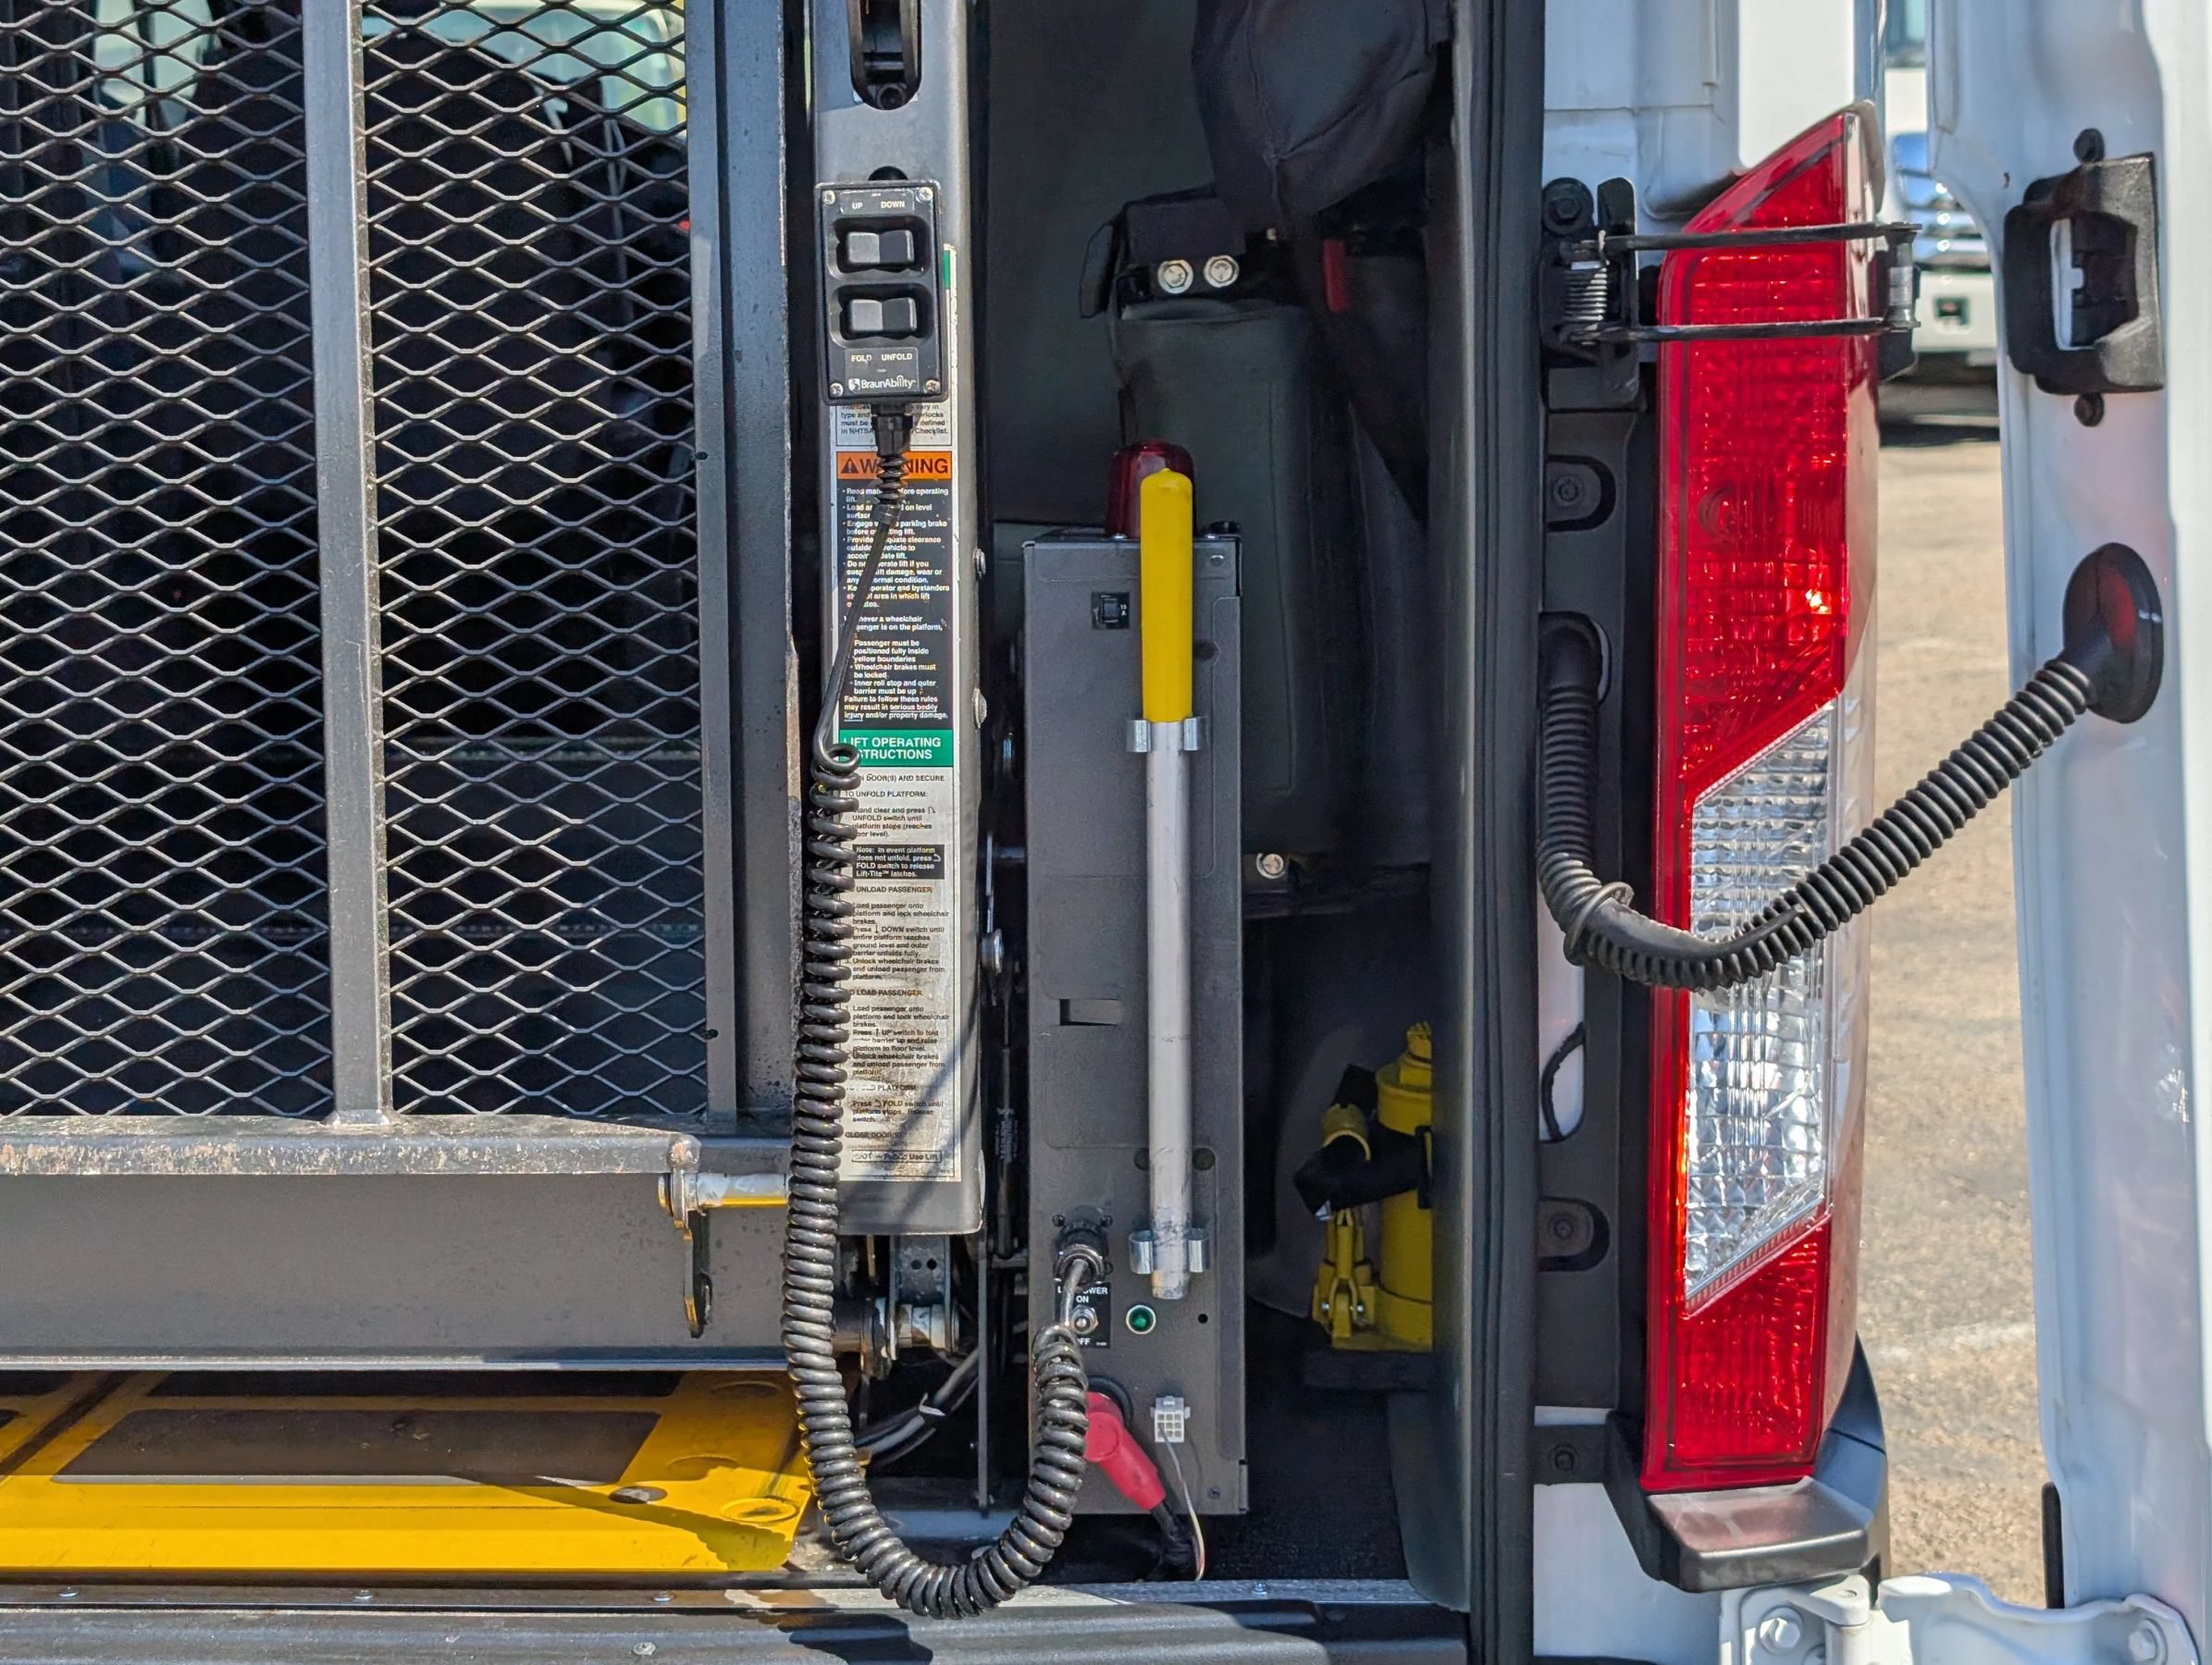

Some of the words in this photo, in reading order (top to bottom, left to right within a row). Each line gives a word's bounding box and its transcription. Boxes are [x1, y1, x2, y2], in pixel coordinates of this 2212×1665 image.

[881, 352, 912, 361] UNFOLD
[861, 375, 913, 389] BraunAbility
[860, 459, 947, 474] WNING
[847, 520, 872, 528] Engage
[900, 520, 926, 528] parking
[892, 648, 907, 656] fully
[872, 737, 941, 747] OPERATING
